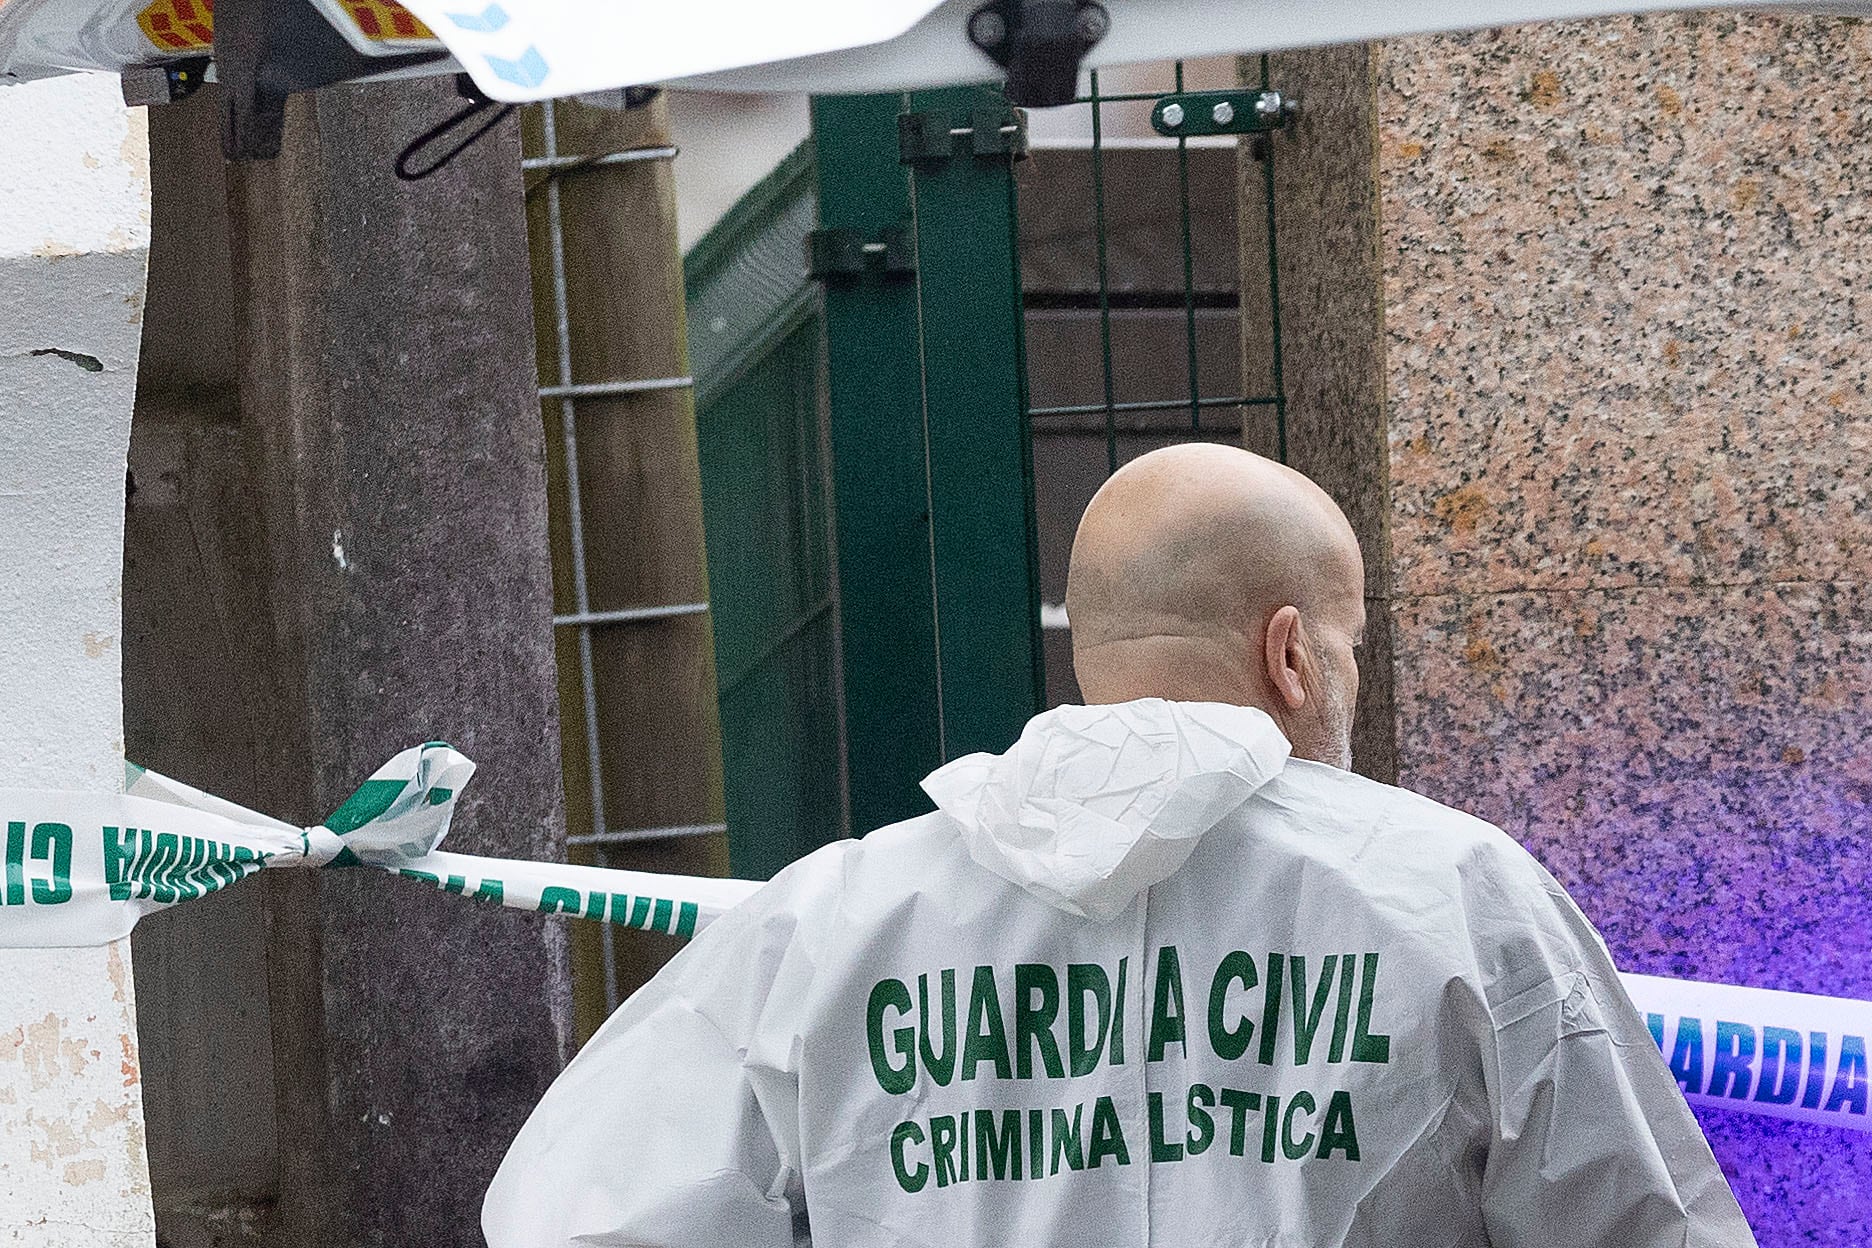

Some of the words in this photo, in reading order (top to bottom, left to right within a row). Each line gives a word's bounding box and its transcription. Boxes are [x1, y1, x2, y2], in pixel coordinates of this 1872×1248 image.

[0, 821, 72, 905] CI
[866, 945, 1187, 1095] GUARDIA
[1207, 950, 1391, 1066] CIVIL
